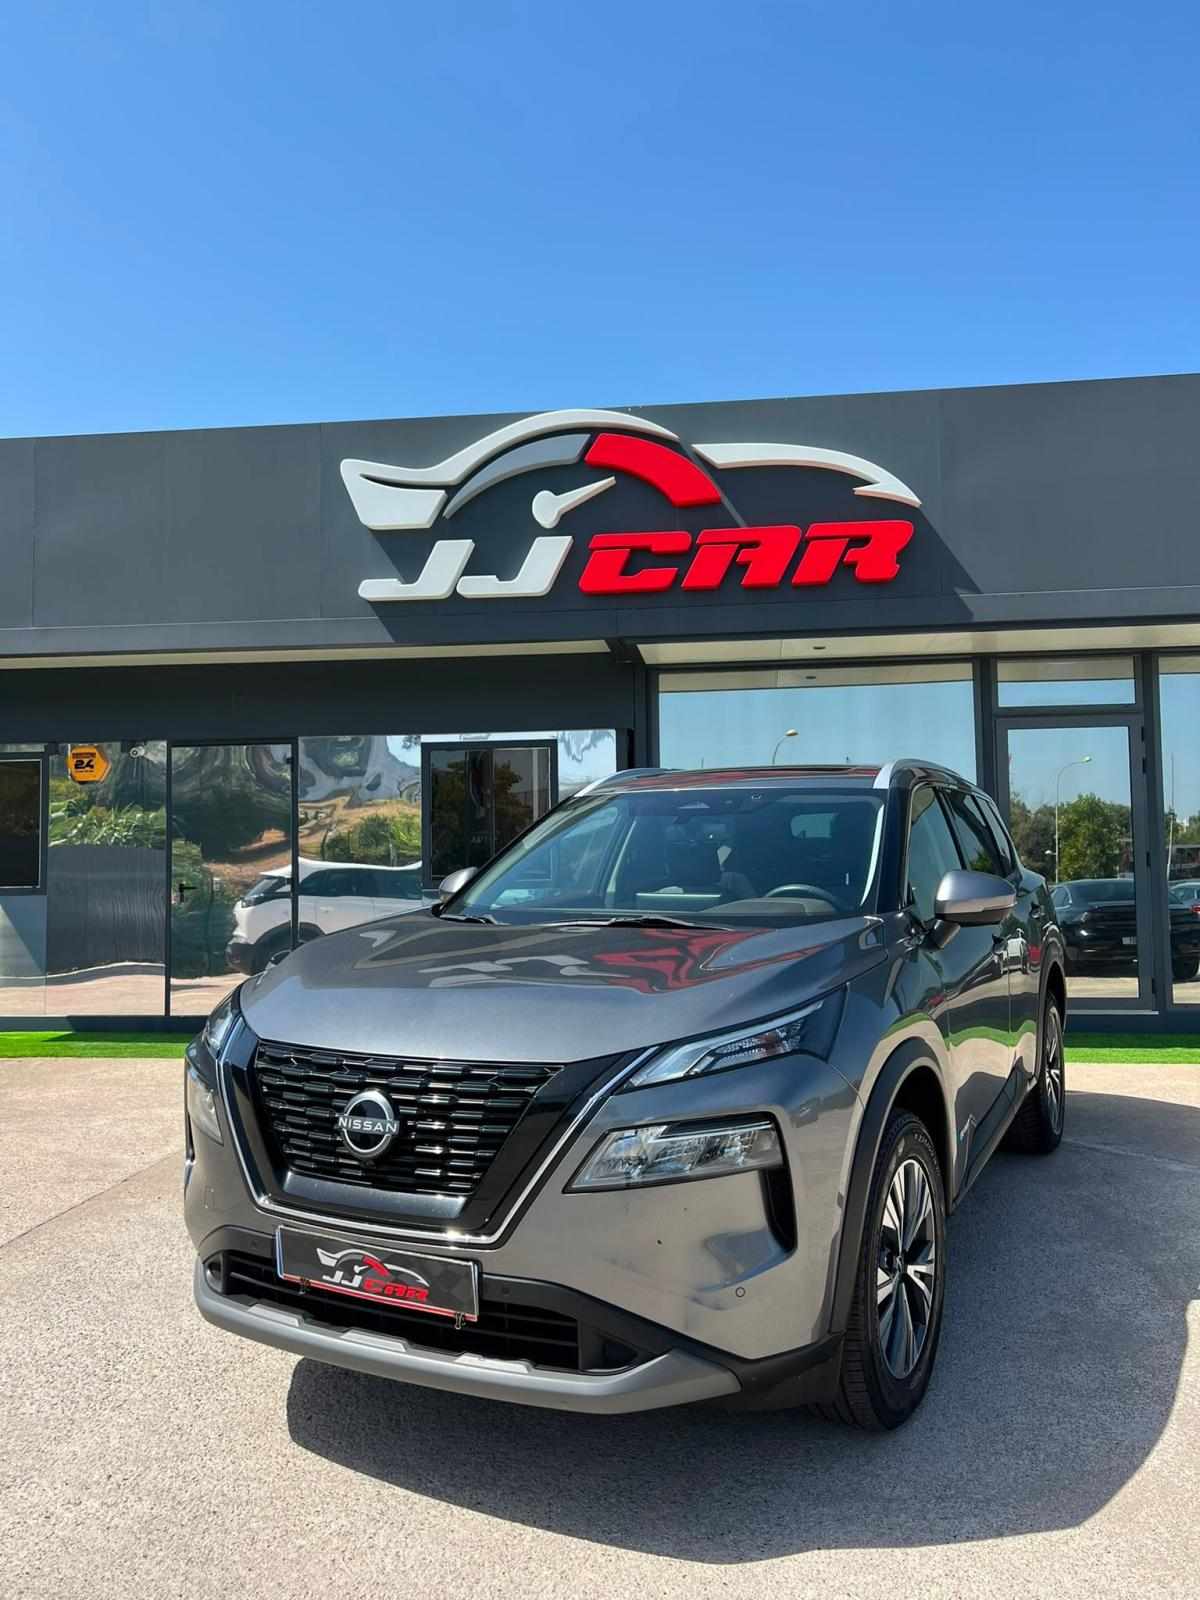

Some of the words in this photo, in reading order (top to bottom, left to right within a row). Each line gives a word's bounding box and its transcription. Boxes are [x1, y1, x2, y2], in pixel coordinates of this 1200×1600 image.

[358, 535, 574, 601] JJ
[578, 519, 915, 594] CAR
[338, 1116, 397, 1133] NISSAN
[363, 1277, 430, 1302] CAR
